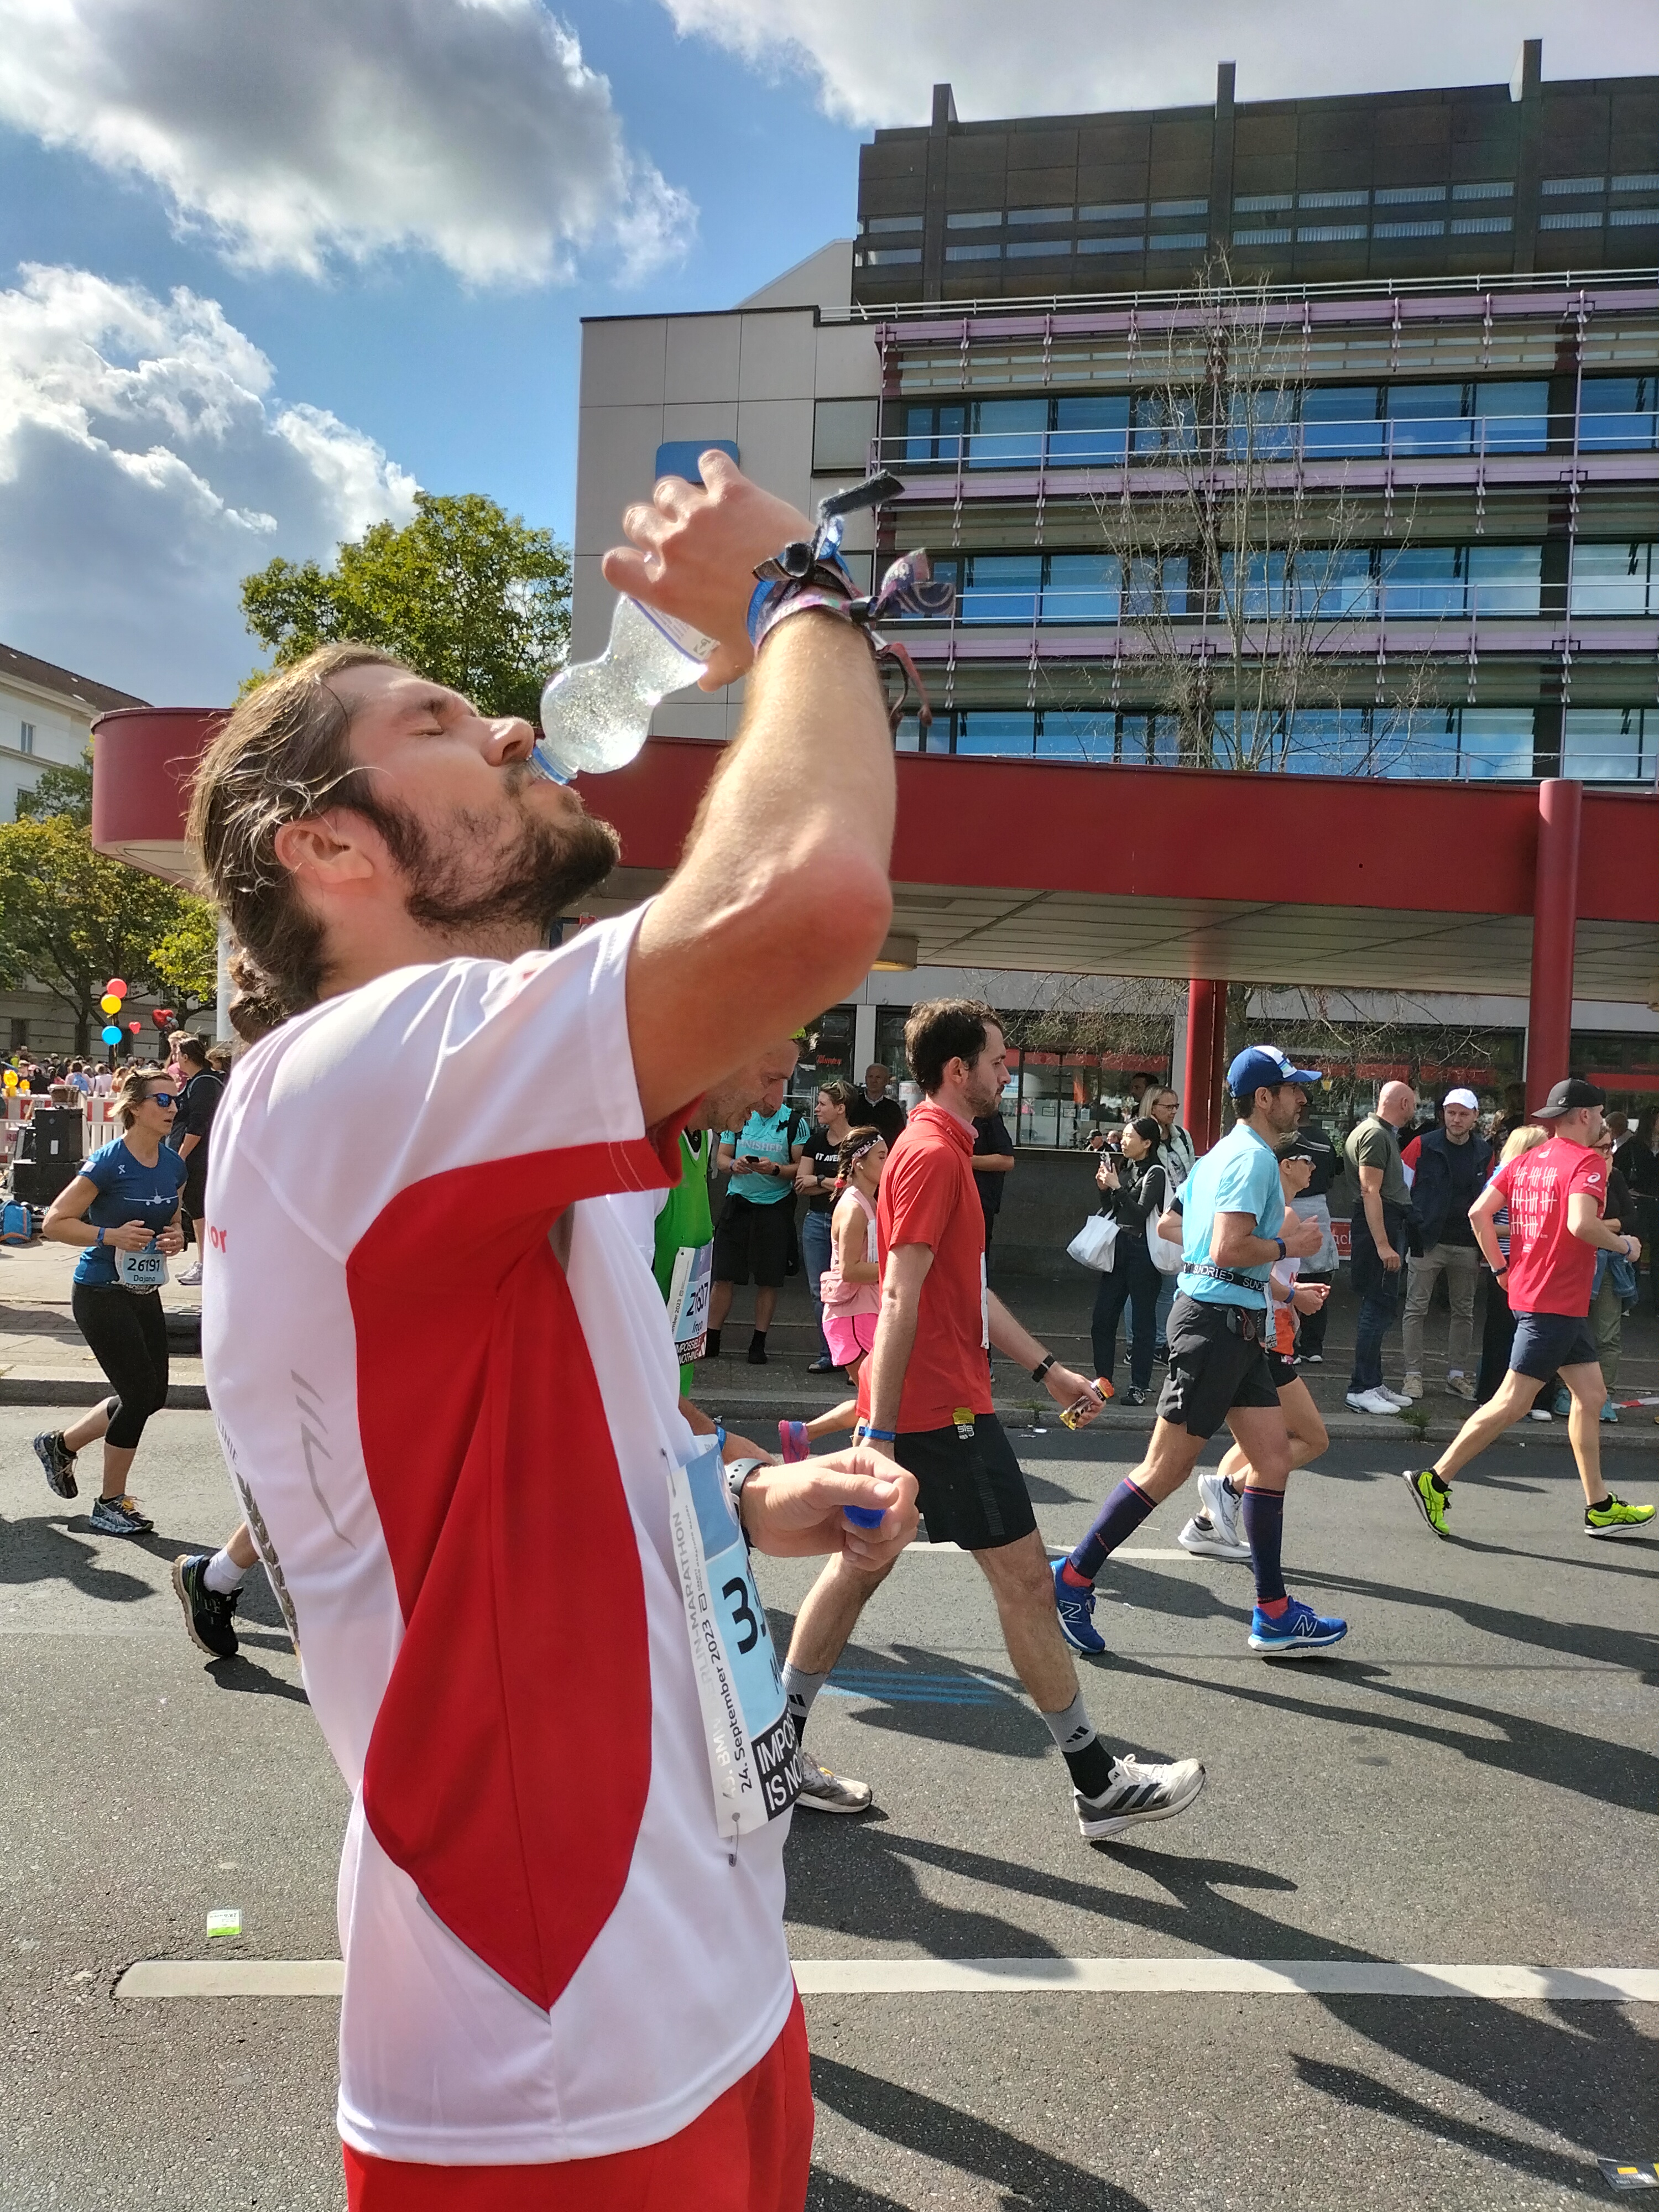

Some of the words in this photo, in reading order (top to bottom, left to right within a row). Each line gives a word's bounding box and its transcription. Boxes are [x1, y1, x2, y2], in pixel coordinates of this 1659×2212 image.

[127, 1258, 160, 1272] 26191
[1193, 1264, 1234, 1282] SUNDRIED
[702, 1619, 721, 1664] 2023
[716, 1666, 745, 1761] September
[739, 1762, 753, 1793] 24.
[766, 1775, 786, 1811] IS
